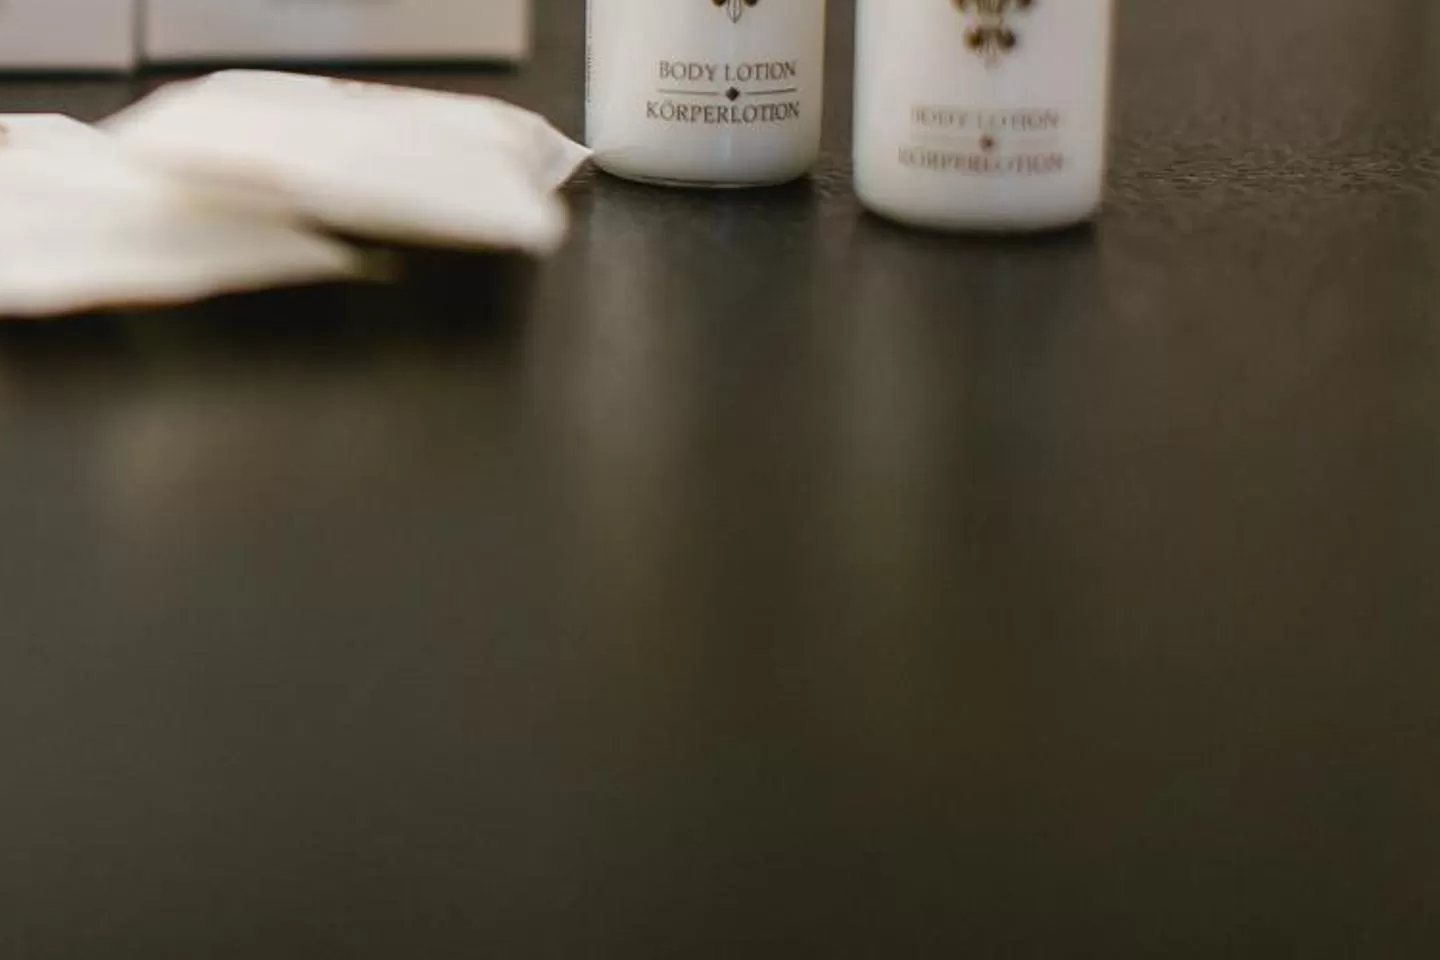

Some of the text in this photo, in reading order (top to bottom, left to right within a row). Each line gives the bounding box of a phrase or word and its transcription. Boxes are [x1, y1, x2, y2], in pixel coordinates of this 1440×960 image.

[659, 60, 797, 82] BODY LOTION
[646, 99, 800, 124] KÖRPERLOTION
